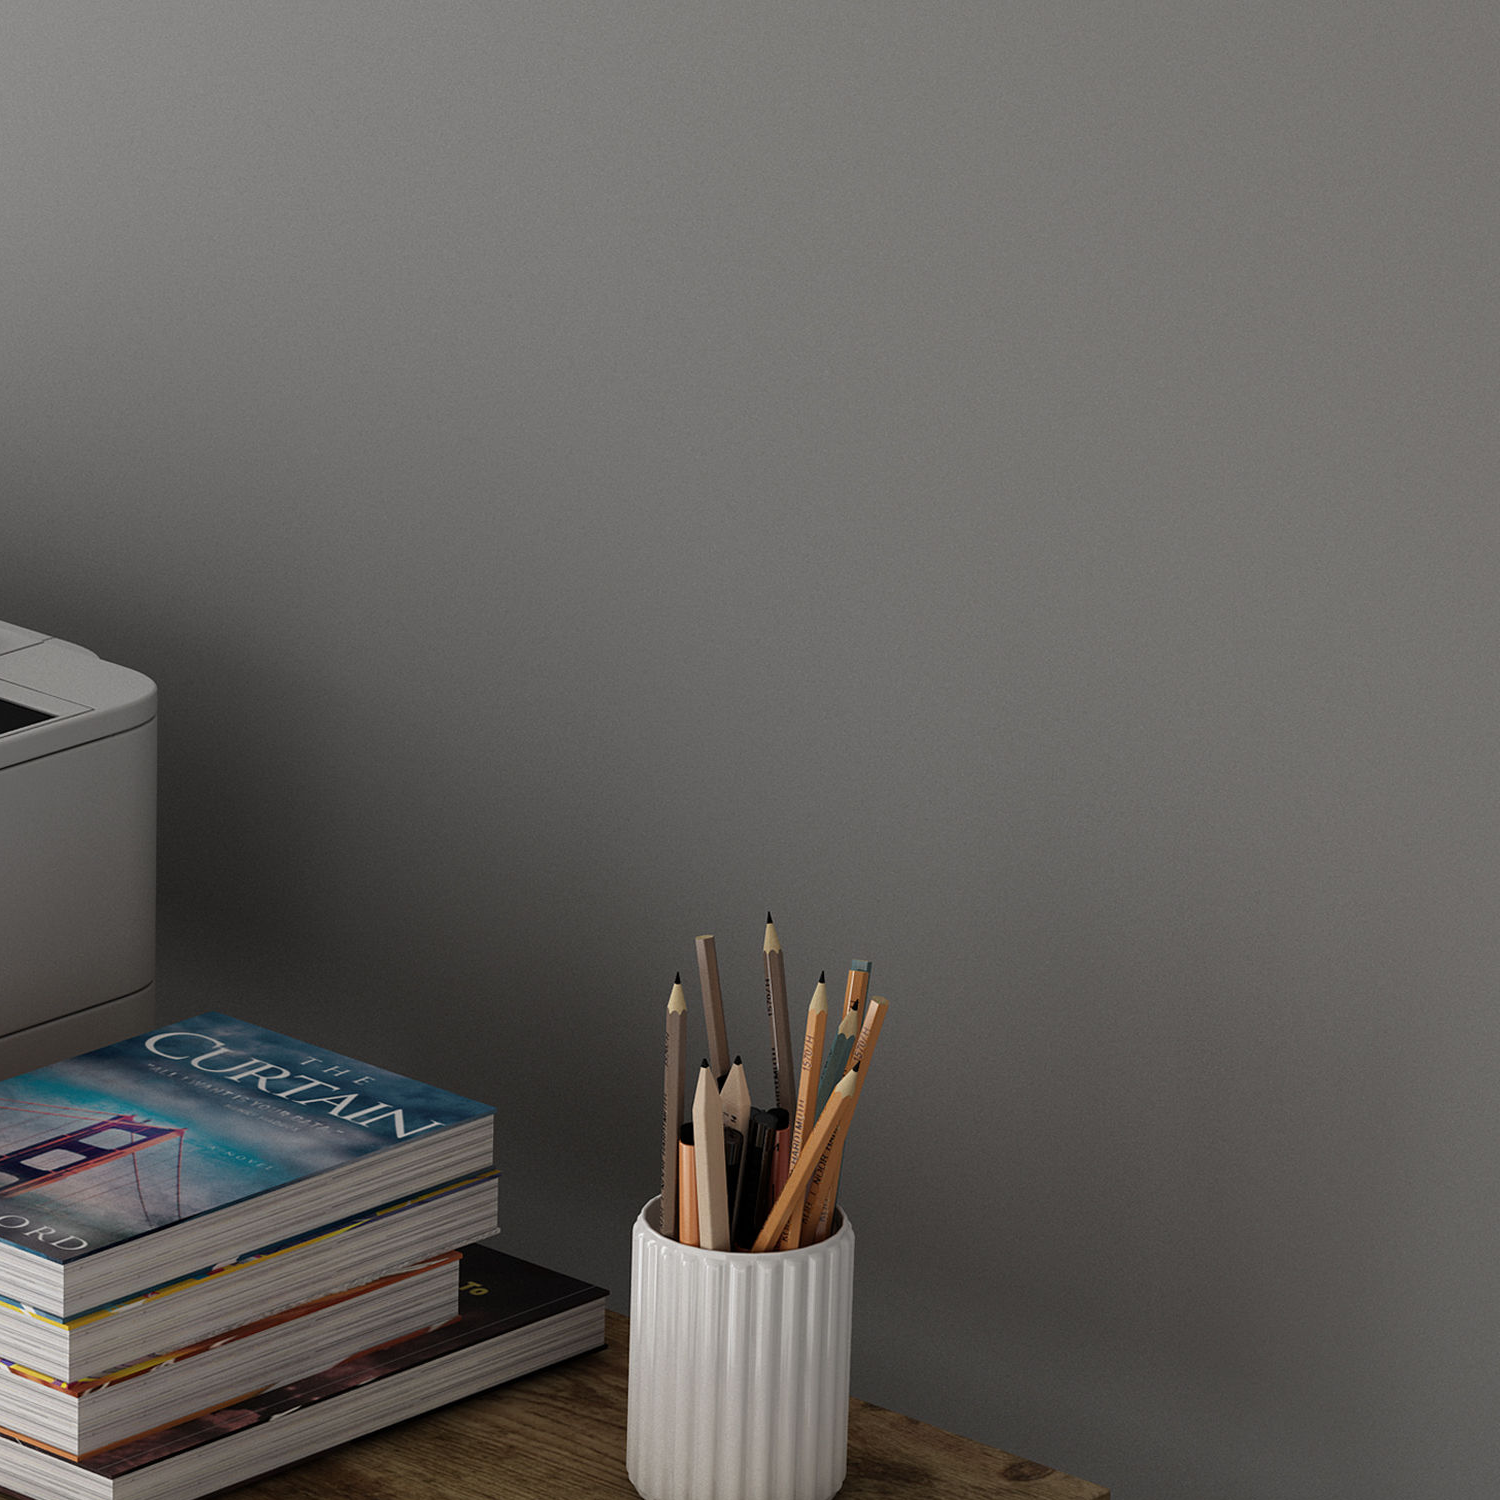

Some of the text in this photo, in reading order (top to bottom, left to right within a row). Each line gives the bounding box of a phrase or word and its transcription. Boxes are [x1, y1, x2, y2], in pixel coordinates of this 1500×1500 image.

[853, 1026, 873, 1062] 1570/H
[144, 1031, 447, 1139] CURTAIN
[300, 1056, 376, 1087] THE
[791, 1034, 815, 1165] HARDTMUTH 1570/H
[813, 1154, 828, 1186] NOOR
